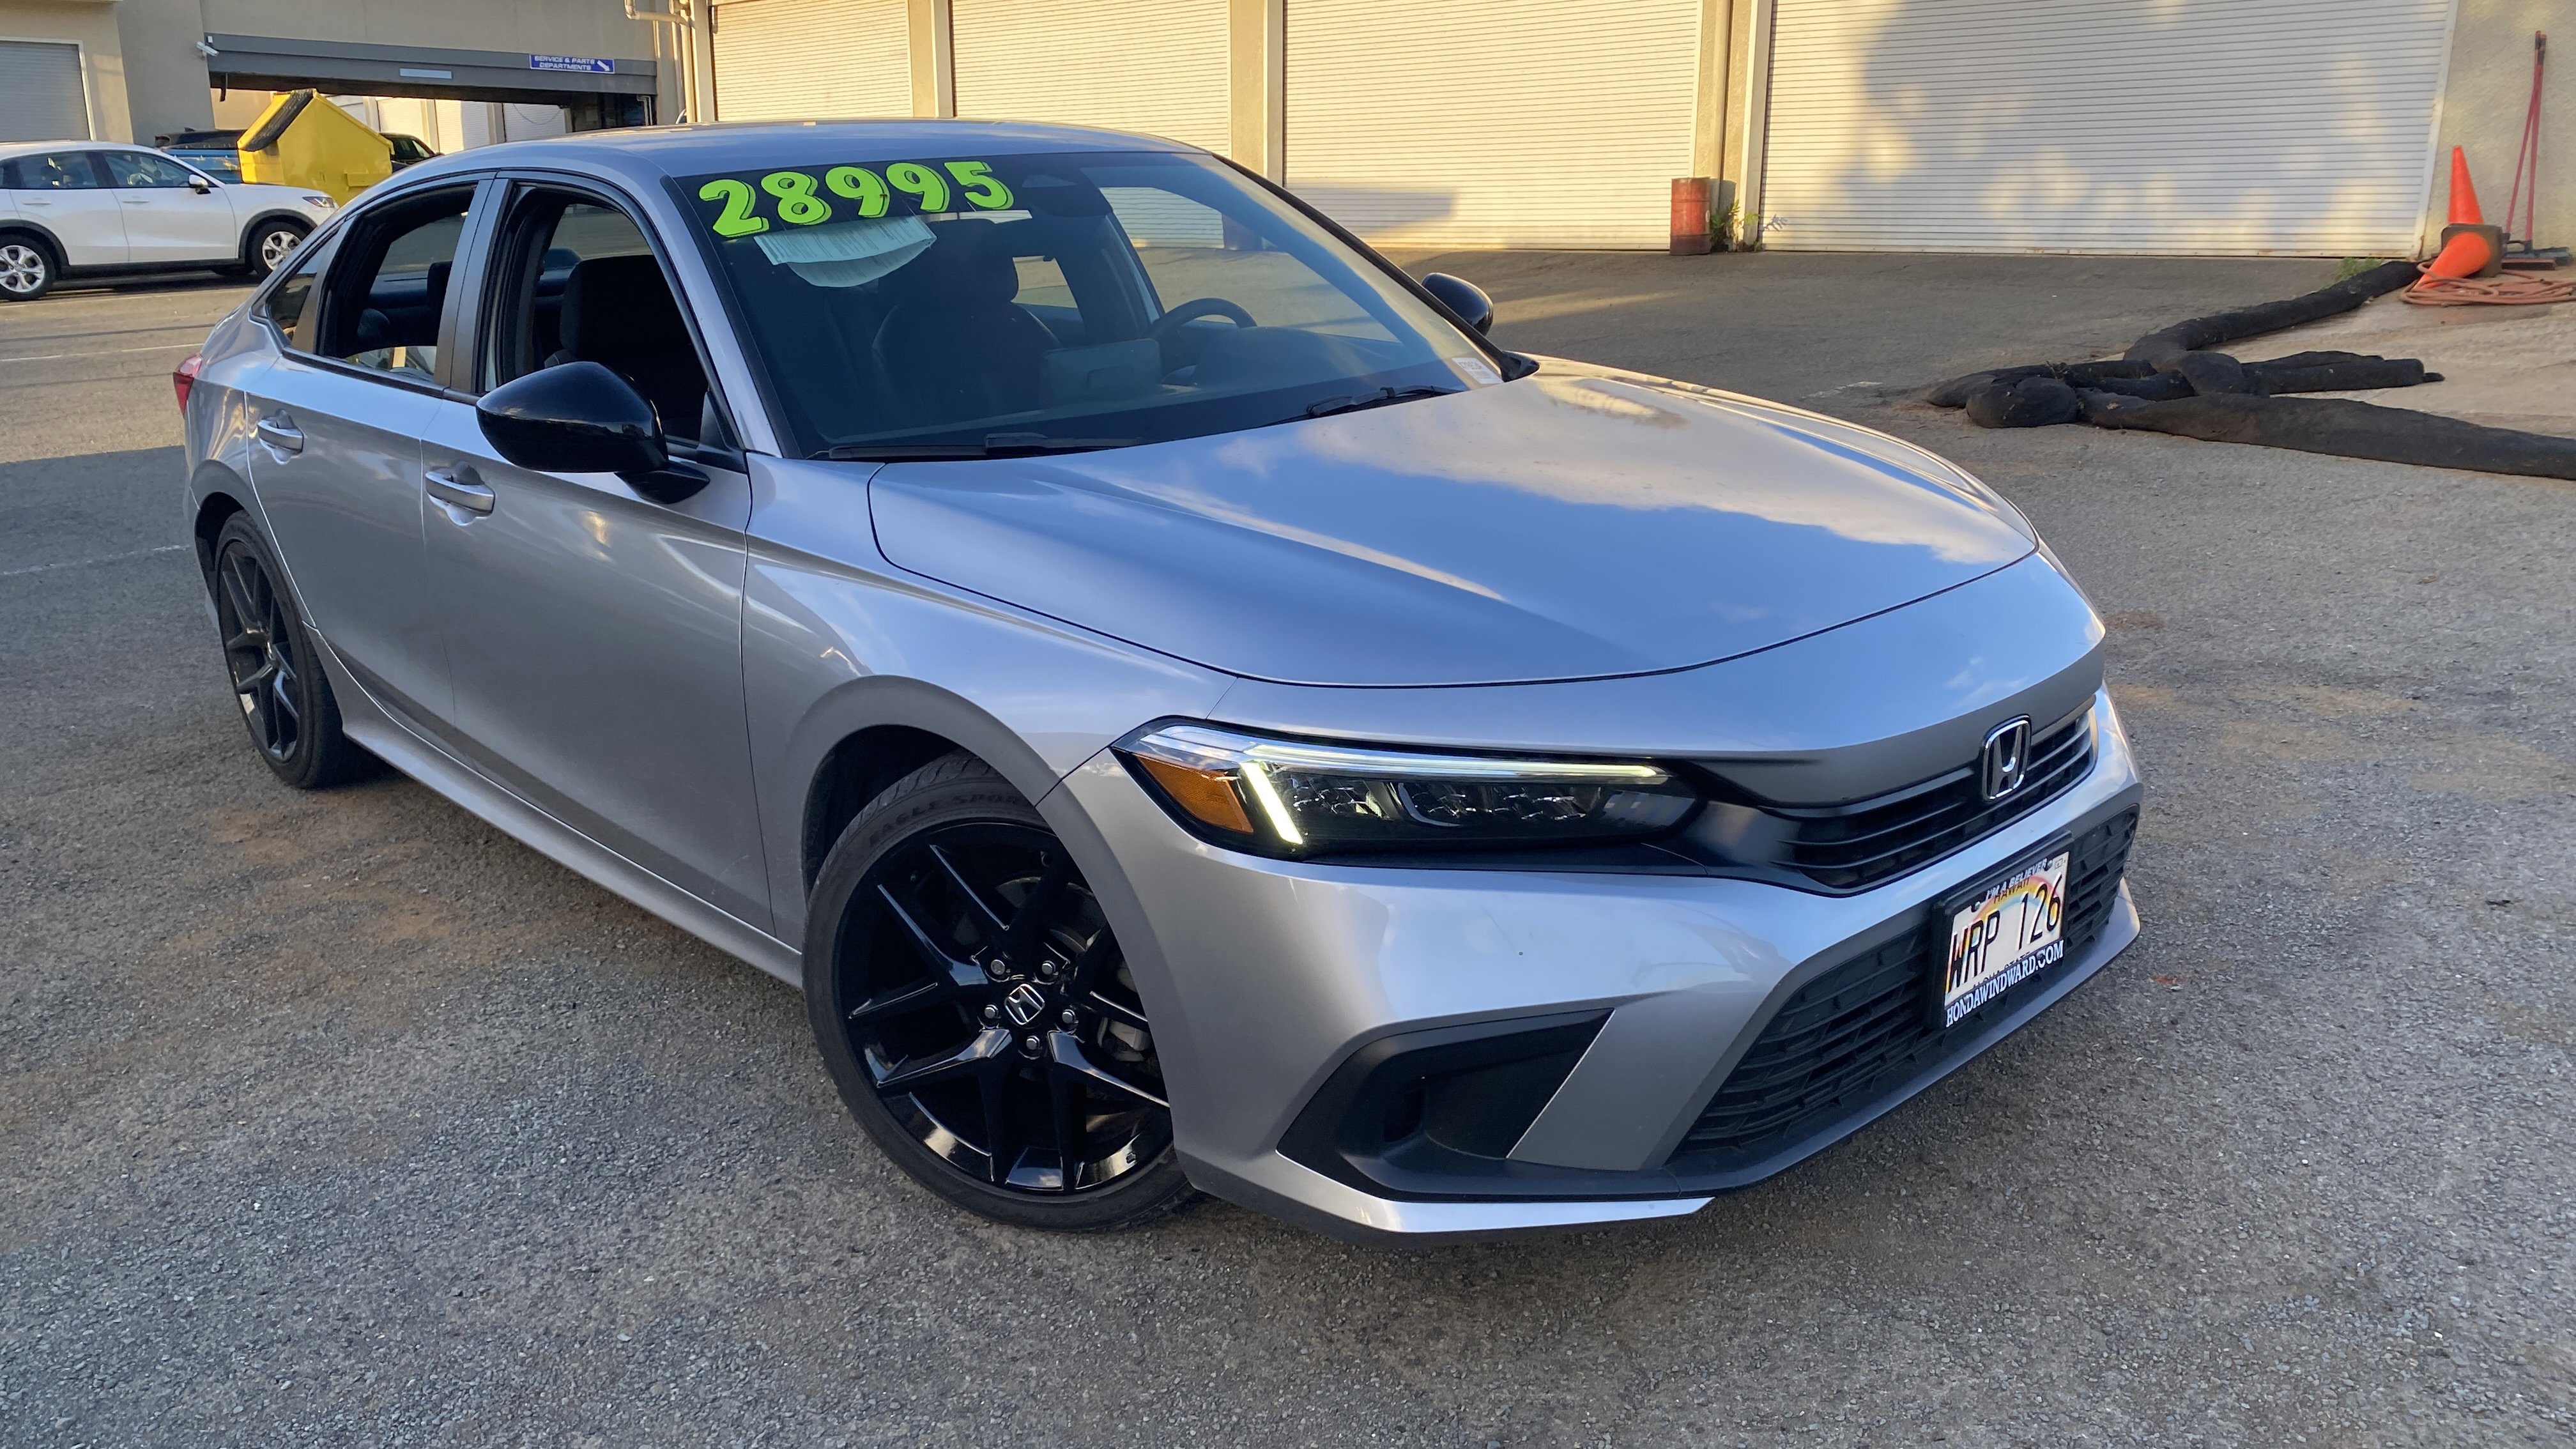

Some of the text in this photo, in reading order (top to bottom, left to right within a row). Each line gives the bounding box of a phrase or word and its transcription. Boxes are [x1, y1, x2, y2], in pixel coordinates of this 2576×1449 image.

[539, 62, 591, 70] DEPARTMENTS
[699, 161, 1014, 238] 28995
[2008, 858, 2048, 889] BELIEVER
[1946, 908, 2000, 993] WRP
[2016, 871, 2062, 951] 126
[1946, 940, 2064, 1027] HONDAWINDWARD.COM
